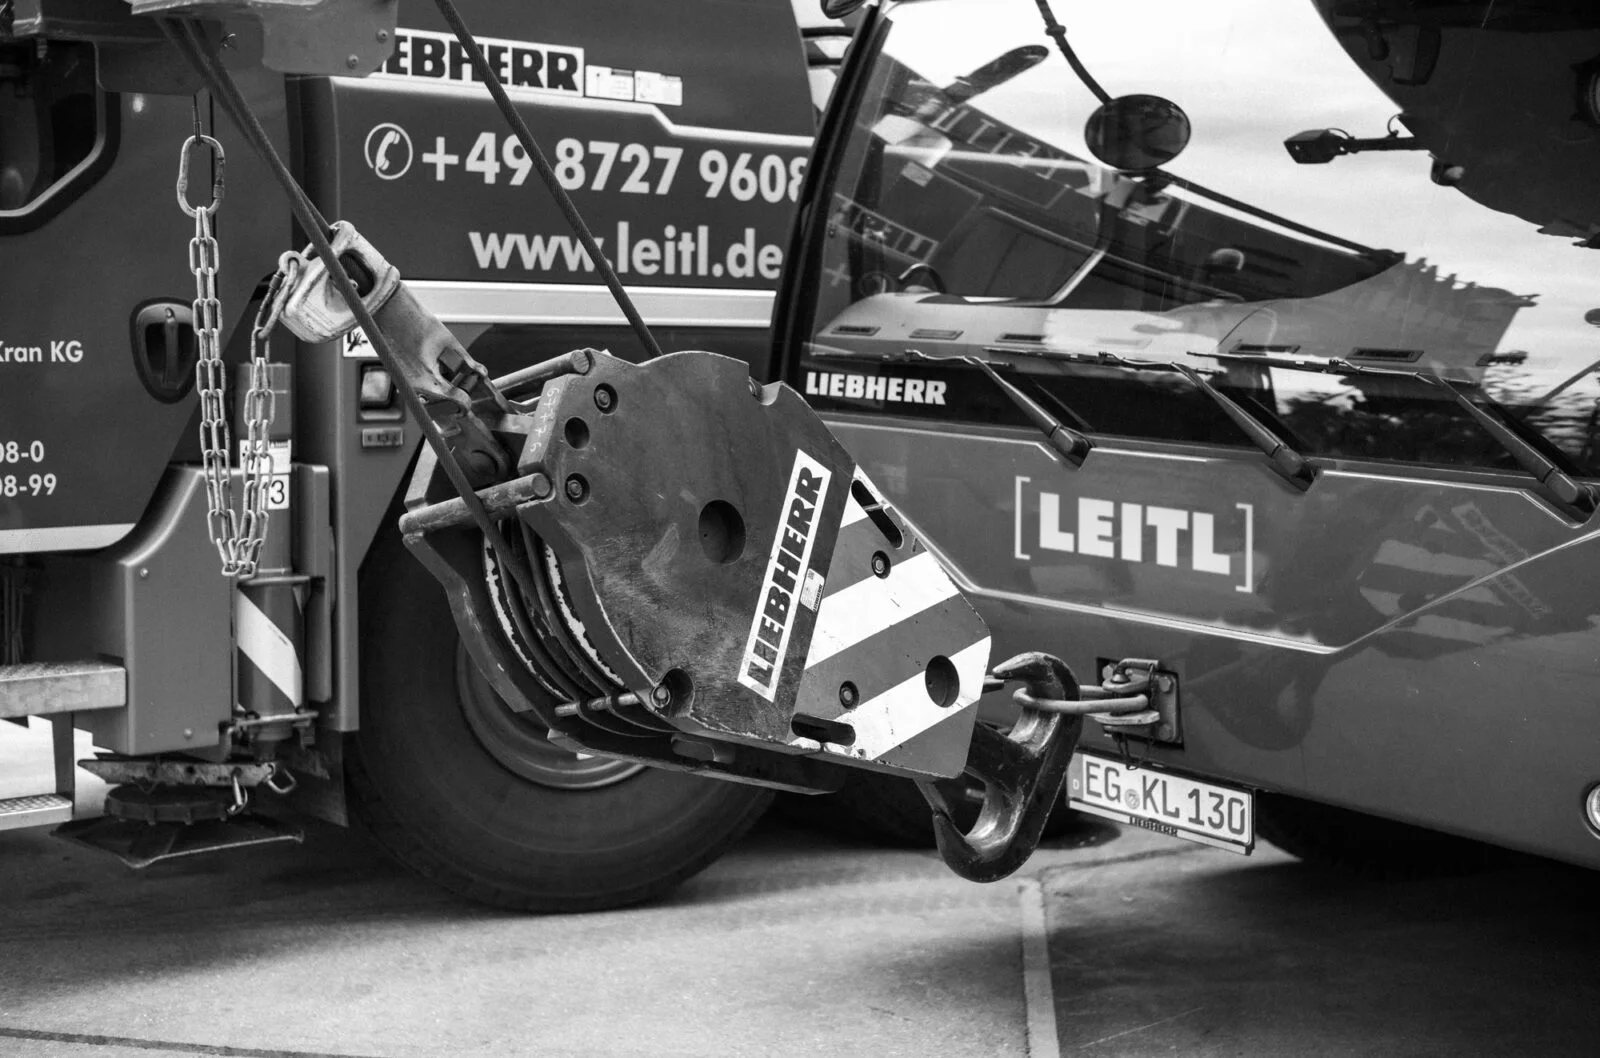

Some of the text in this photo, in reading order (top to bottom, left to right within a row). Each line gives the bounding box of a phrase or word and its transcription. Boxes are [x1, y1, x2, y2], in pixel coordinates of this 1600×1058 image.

[374, 35, 579, 92] EBHERR
[422, 132, 533, 186] +49
[554, 138, 684, 195] 8727
[0, 340, 83, 363] ran KG
[806, 371, 946, 405] LIEBHERR
[0, 473, 57, 497] 8-99
[747, 466, 824, 689] LIEBHERR
[1085, 761, 1121, 803] EG
